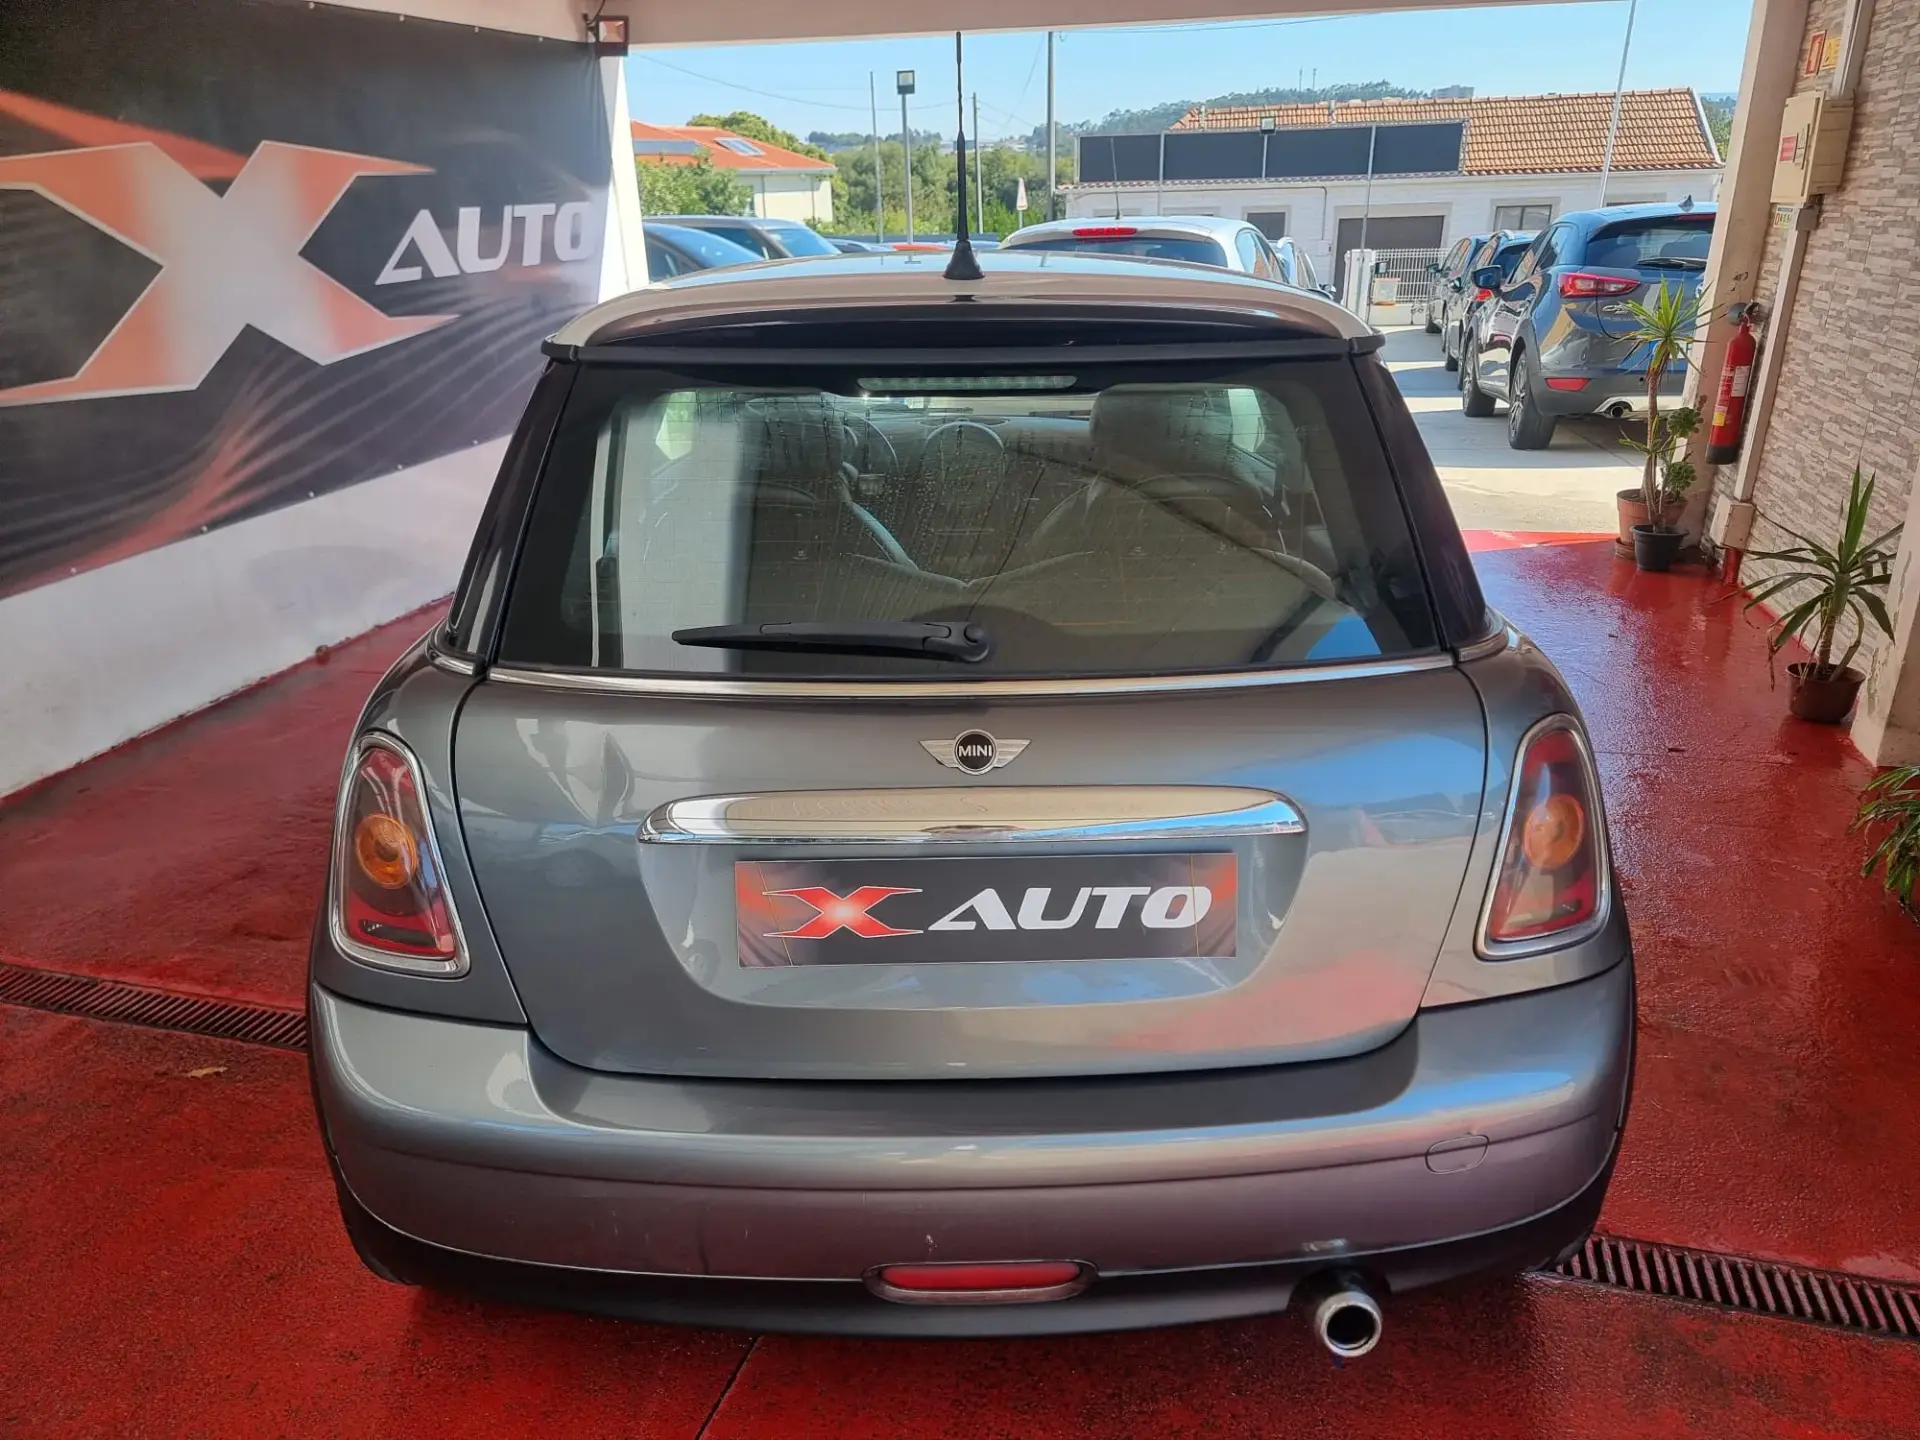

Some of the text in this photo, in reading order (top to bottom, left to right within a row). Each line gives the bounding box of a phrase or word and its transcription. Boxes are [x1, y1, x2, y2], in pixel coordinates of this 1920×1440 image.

[0, 140, 599, 407] X AUTO
[958, 744, 992, 757] MINI
[762, 886, 1213, 939] X AUTO
